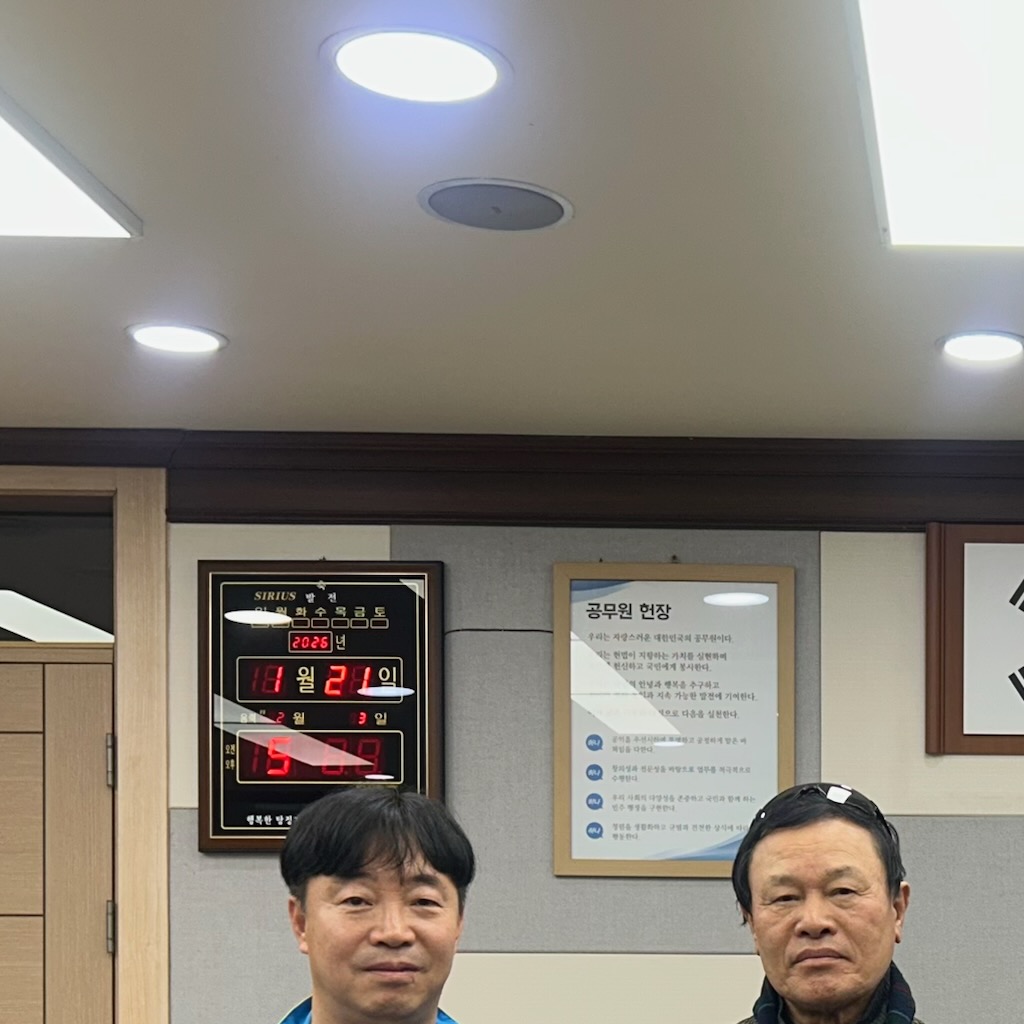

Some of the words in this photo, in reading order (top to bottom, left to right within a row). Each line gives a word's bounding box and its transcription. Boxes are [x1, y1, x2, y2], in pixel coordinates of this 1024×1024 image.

[254, 591, 297, 601] SIRIUS
[295, 606, 307, 617] 화
[315, 606, 327, 617] 수
[335, 606, 347, 617] 목
[354, 606, 366, 617] 금
[374, 606, 386, 617] 토
[586, 603, 632, 619] 공무원
[640, 603, 671, 620] 헌장
[292, 636, 329, 648] 2026
[336, 634, 346, 650] 년
[588, 633, 610, 642] 우리는
[613, 633, 651, 642] 자랑스러운
[654, 634, 691, 642] 대한민국의
[613, 652, 636, 660] 헌법이
[638, 652, 669, 660] 지향하는
[671, 652, 693, 660] 가치를
[697, 652, 727, 661] 실현하며
[646, 663, 677, 671] 국민에게
[274, 666, 284, 693] 1
[296, 666, 315, 693] 월
[324, 665, 372, 696] 21
[638, 681, 661, 689] 안녕과
[664, 681, 686, 690] 행복을
[689, 681, 720, 690] 추구하고
[656, 692, 671, 700] 지속
[674, 692, 697, 700] 가능한
[699, 692, 722, 701] 발전에
[293, 712, 305, 725] 월
[358, 712, 367, 725] 3
[374, 712, 388, 725] 일
[682, 710, 704, 718] 다음을
[246, 814, 272, 825] 행복한
[275, 814, 298, 825] 탕정
